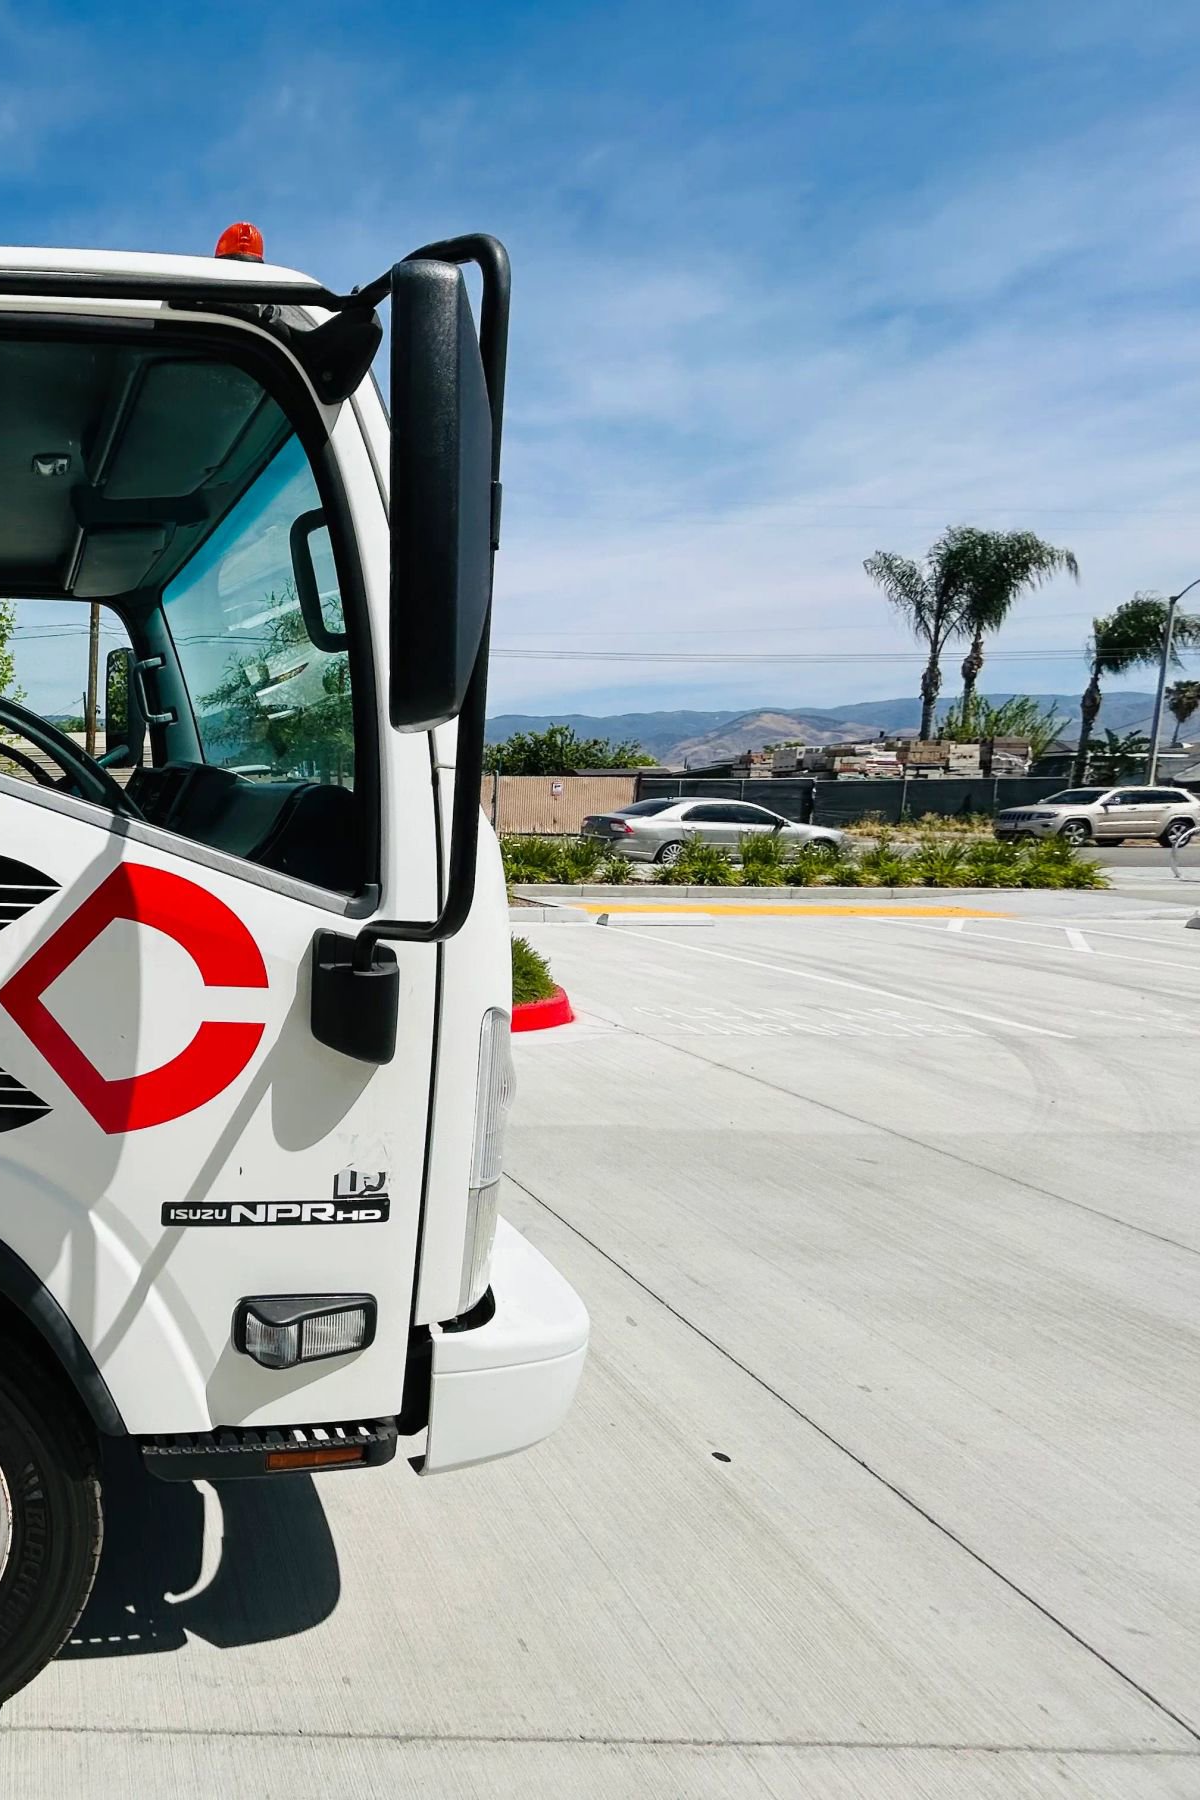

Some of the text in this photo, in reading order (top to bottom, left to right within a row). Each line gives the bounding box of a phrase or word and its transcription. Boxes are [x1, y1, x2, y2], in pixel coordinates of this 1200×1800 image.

[170, 1204, 382, 1223] ISUZU NPR HD
